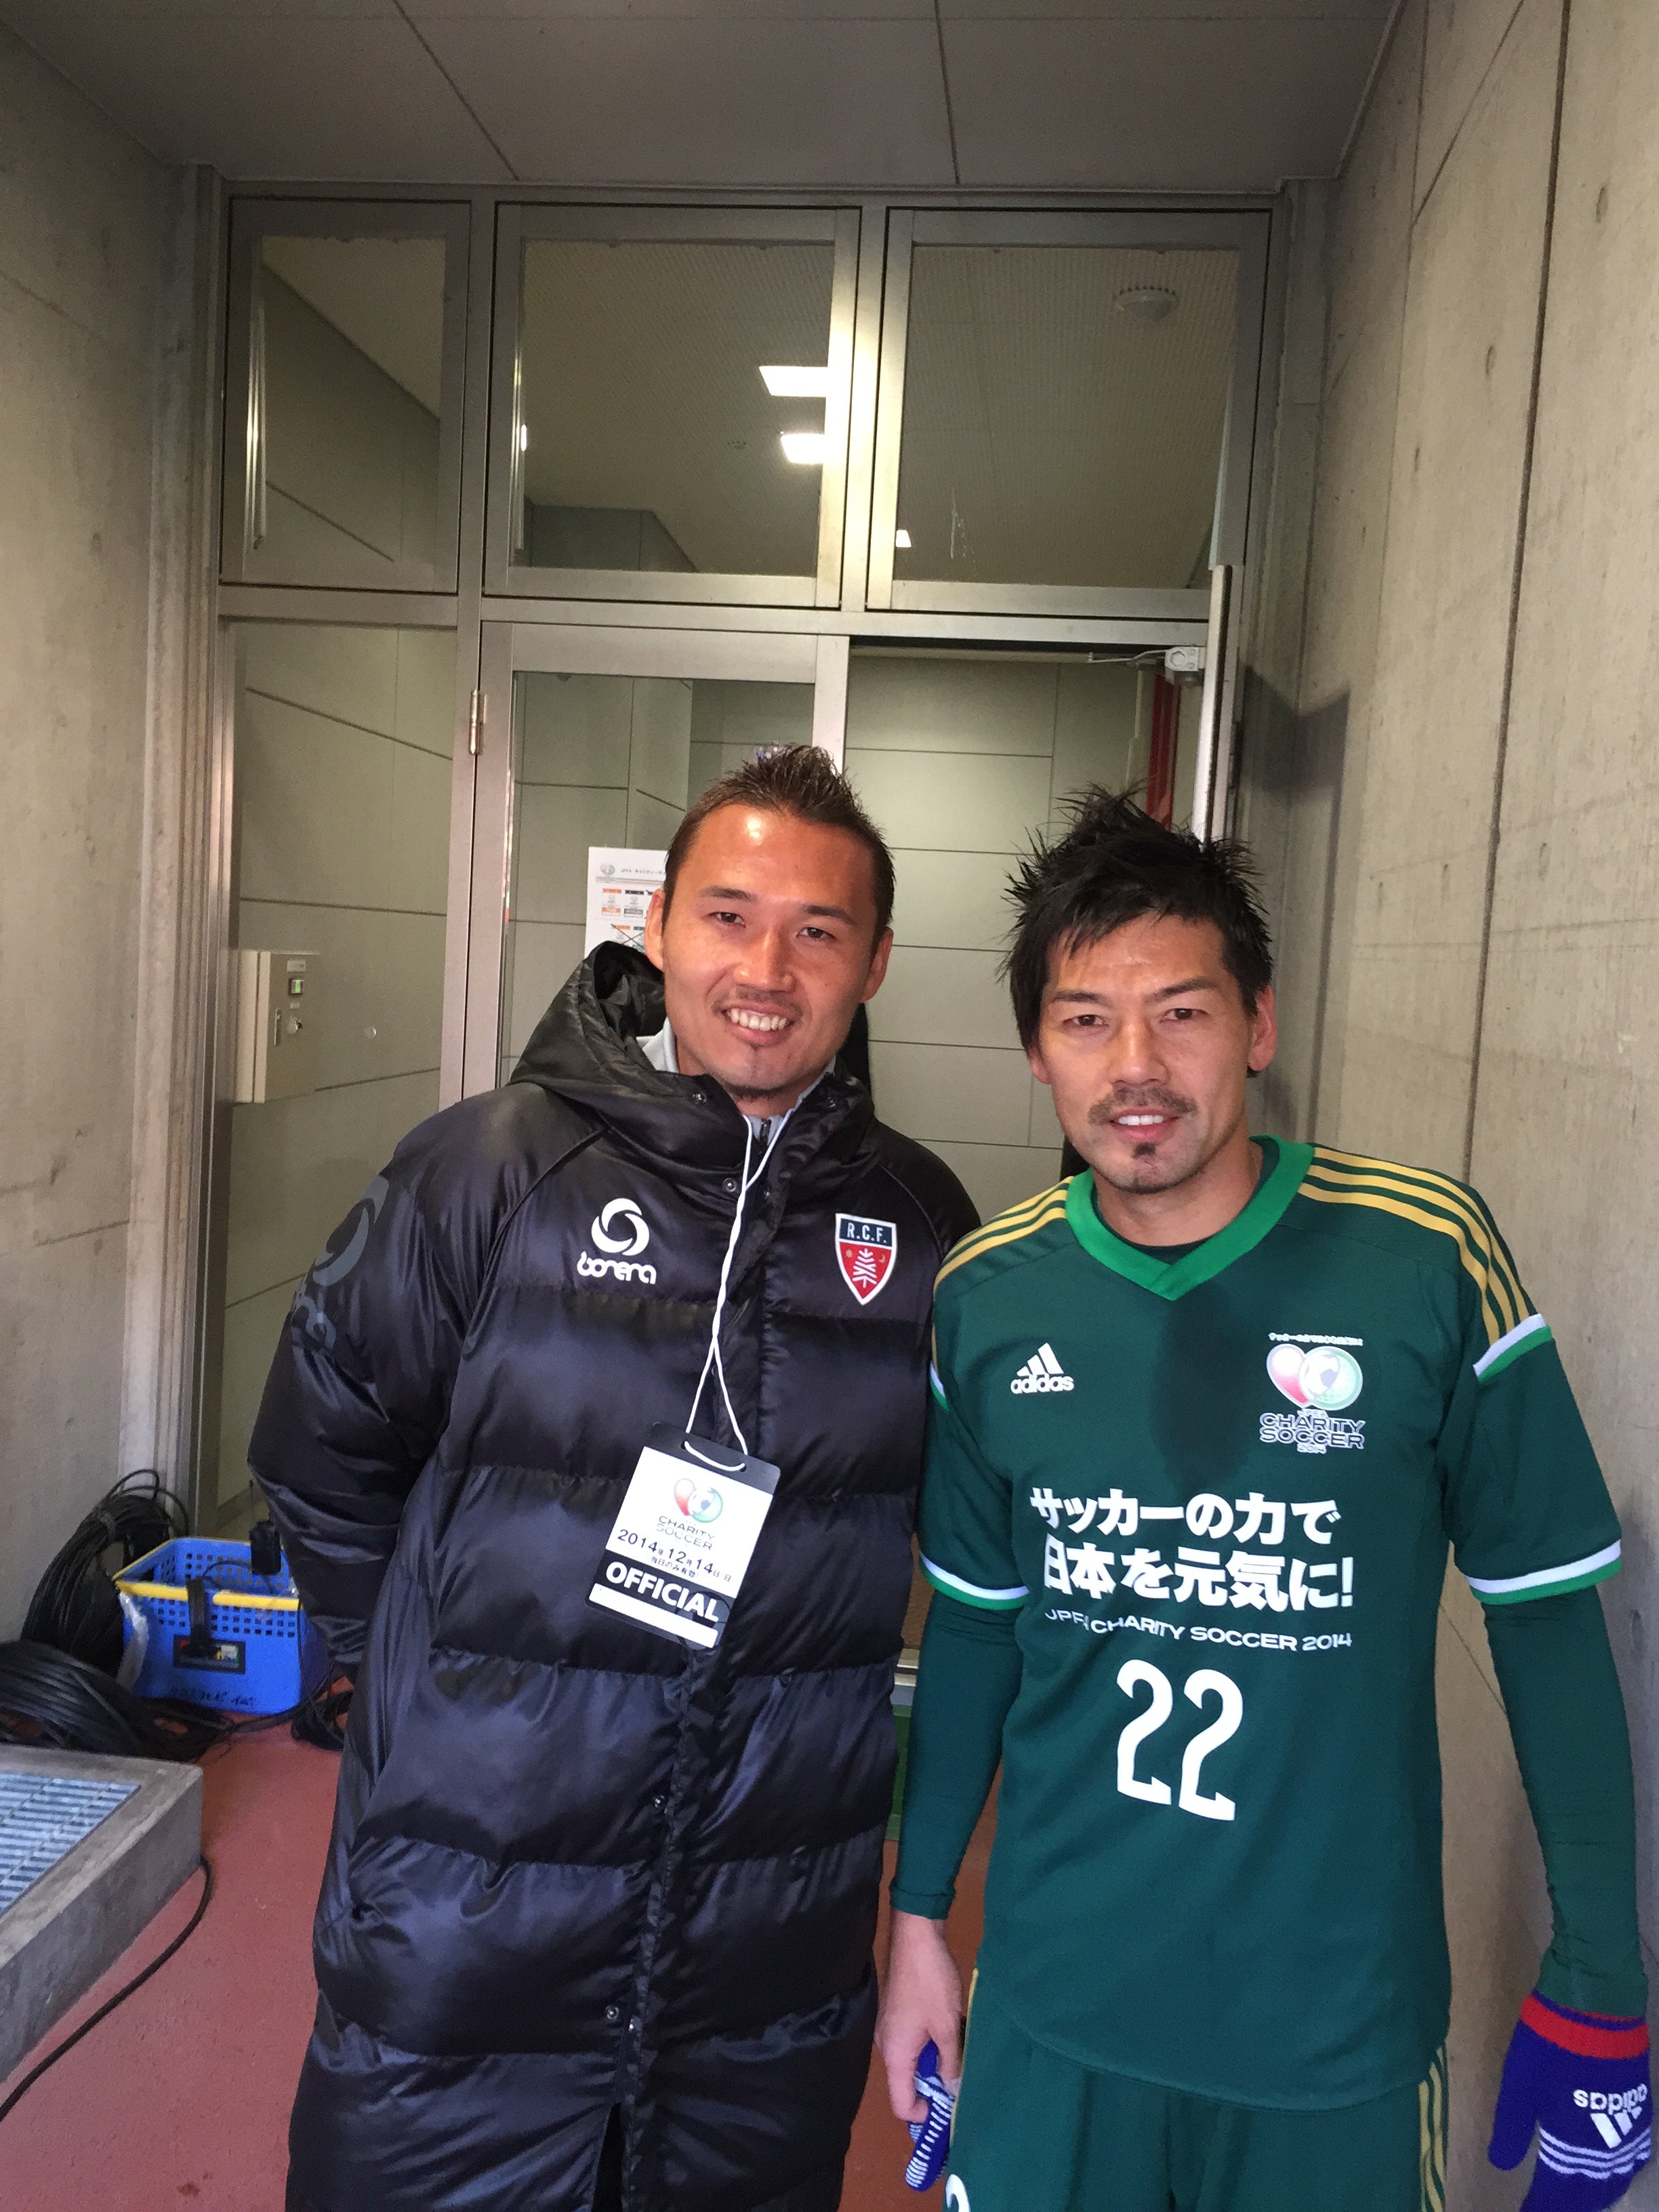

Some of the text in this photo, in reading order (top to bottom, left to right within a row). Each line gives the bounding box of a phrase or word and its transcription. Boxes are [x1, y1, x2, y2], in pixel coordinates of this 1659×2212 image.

[1010, 1371, 1075, 1394] adidas
[1260, 1413, 1366, 1435] CHARITY
[1260, 1427, 1365, 1449] SOCCER
[659, 1515, 716, 1540] CHARITY
[1029, 1487, 1342, 1544] サッカーの力で
[655, 1523, 713, 1551] SOCCER
[606, 1561, 719, 1622] OFFICIAL
[1090, 1616, 1185, 1640] CHARITY
[1190, 1626, 1297, 1652] SOCCER
[1301, 1632, 1353, 1652] 2014
[1117, 1659, 1244, 1821] 22
